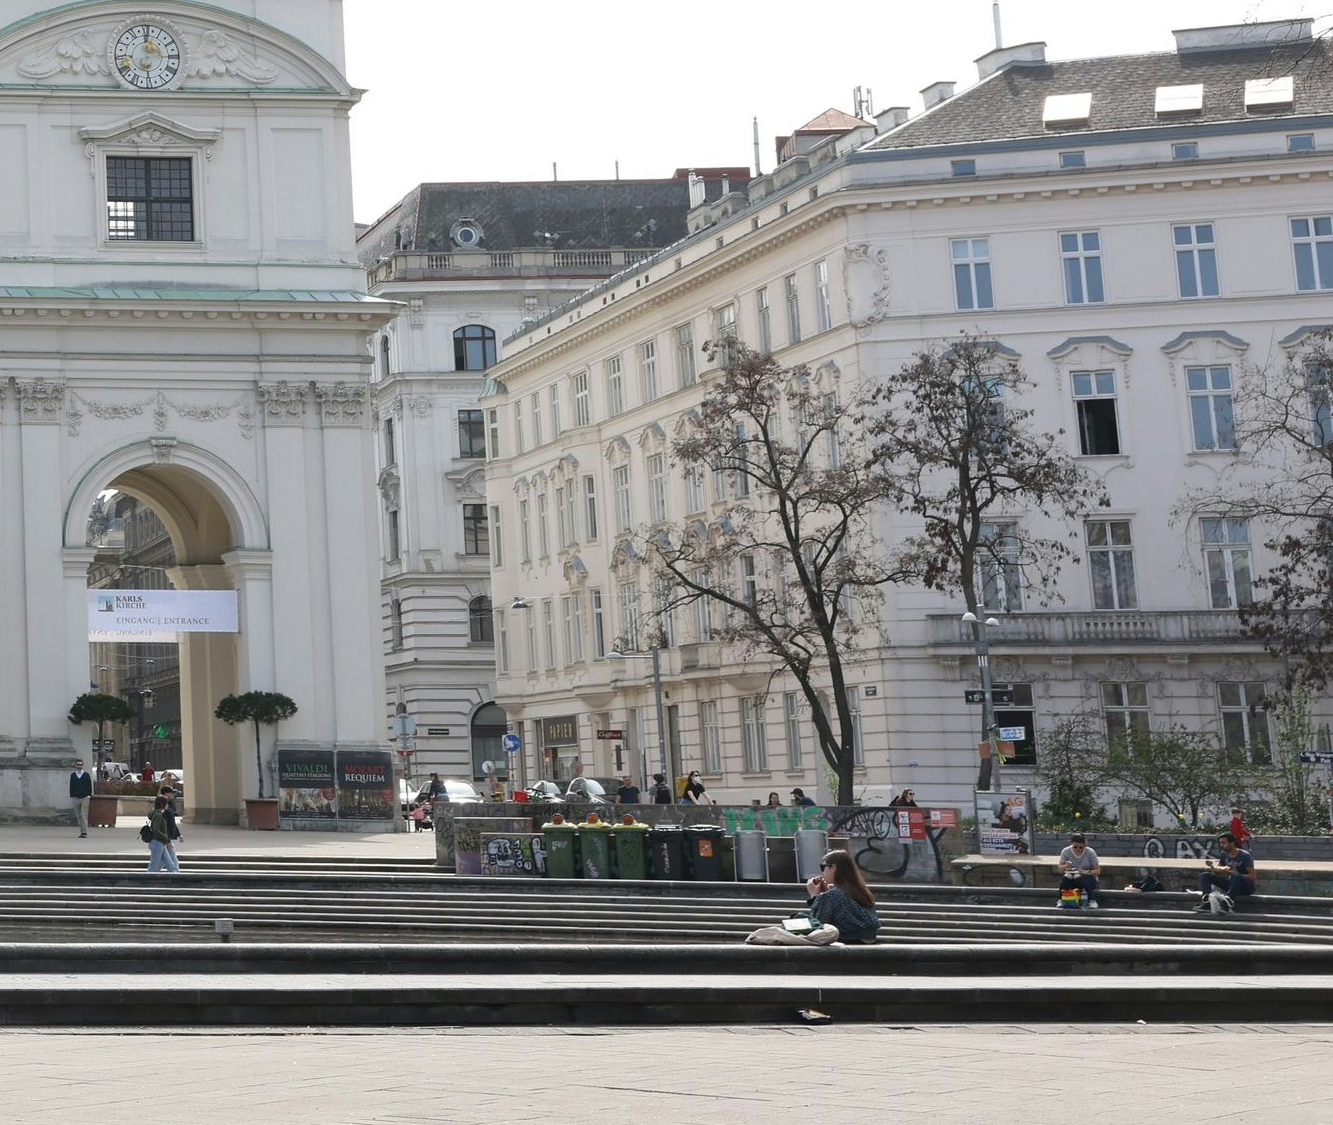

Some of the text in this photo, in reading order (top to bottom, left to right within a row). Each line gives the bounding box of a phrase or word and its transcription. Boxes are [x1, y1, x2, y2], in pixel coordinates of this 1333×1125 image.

[115, 595, 143, 603] KARLS
[164, 617, 210, 625] ENTRANCE
[548, 722, 573, 740] PAPIER
[286, 763, 328, 773] VIVALDI
[345, 765, 385, 774] MOZART
[345, 773, 386, 783] REQUIEM
